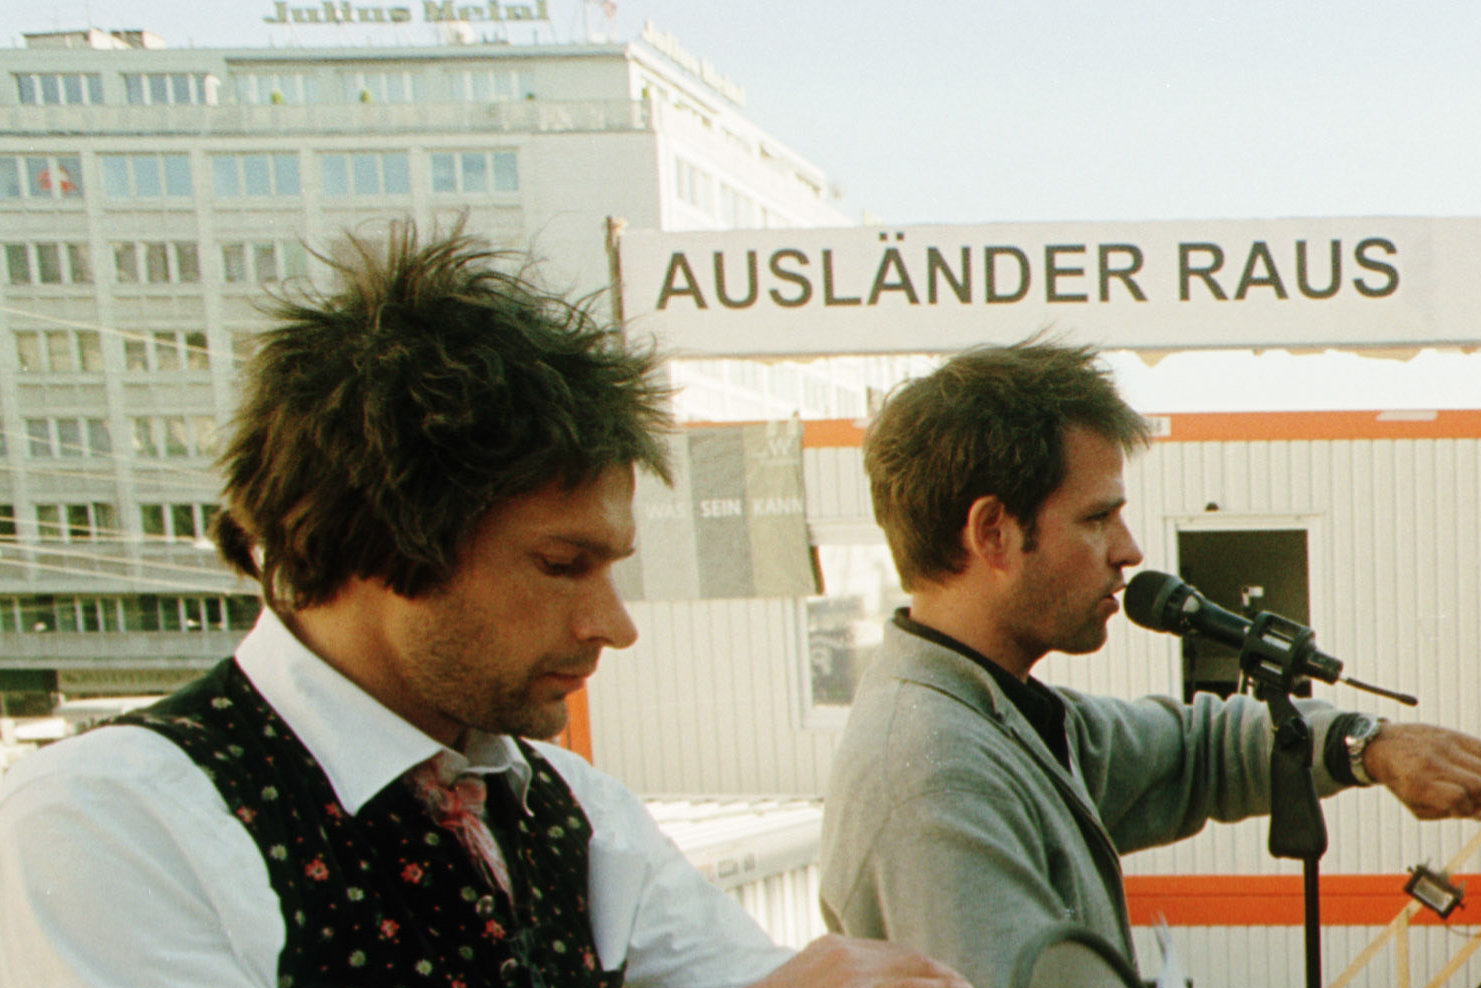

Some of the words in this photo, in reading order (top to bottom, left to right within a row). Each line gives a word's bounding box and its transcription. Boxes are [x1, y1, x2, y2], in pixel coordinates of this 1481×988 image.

[262, 0, 412, 24] Julius
[422, 0, 550, 22] Meinl
[655, 231, 1150, 312] AUSLÄNDER
[1177, 237, 1401, 303] RAUS
[700, 499, 742, 519] SEIN
[752, 498, 803, 516] KANN
